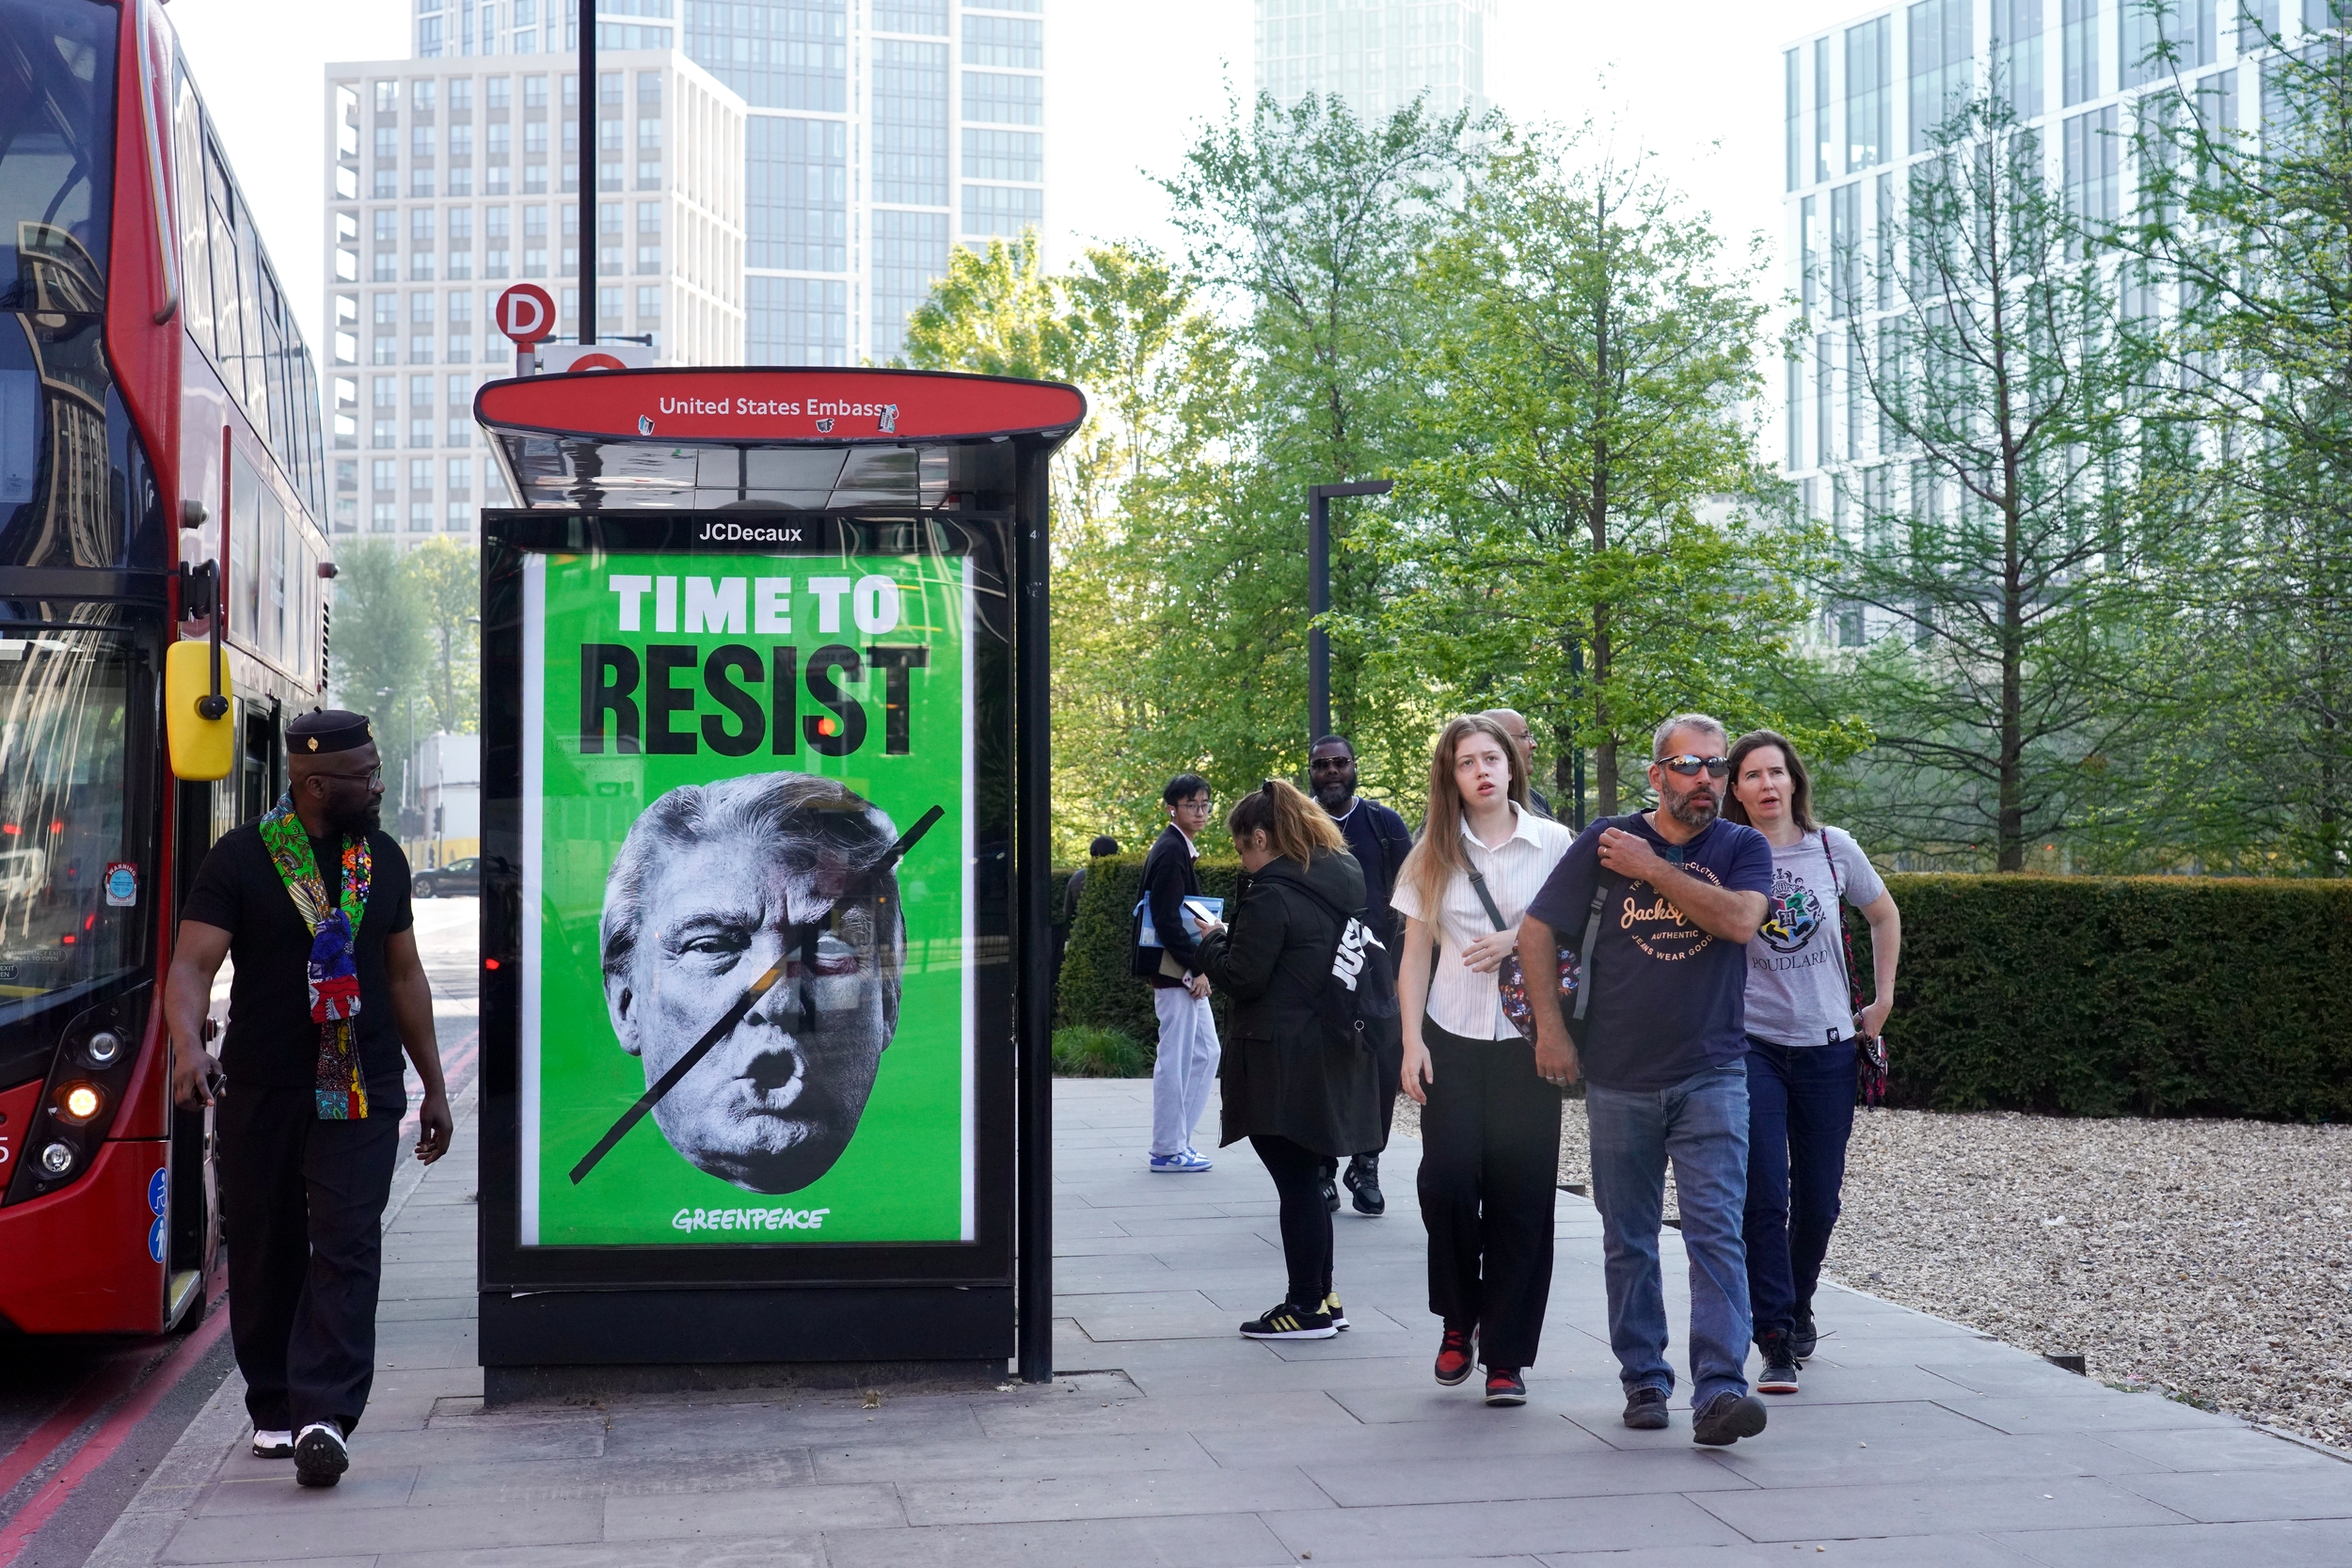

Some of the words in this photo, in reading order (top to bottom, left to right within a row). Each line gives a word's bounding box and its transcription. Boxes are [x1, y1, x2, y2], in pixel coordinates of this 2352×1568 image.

[507, 293, 544, 335] D
[660, 397, 729, 415] United
[737, 398, 800, 416] States
[807, 399, 888, 417] Embass
[699, 523, 803, 542] JCDecaux
[609, 575, 791, 634] TIME
[808, 574, 899, 634] TO
[580, 643, 930, 757] RESIST
[108, 863, 136, 877] WARNING
[1632, 934, 1654, 956] JEANS
[1656, 951, 1685, 960] WEAR
[1688, 934, 1712, 956] GOOD
[1651, 929, 1699, 941] AUTHENTIC
[1752, 949, 1828, 972] POUDLARD
[672, 1208, 830, 1234] GREENPEACE
